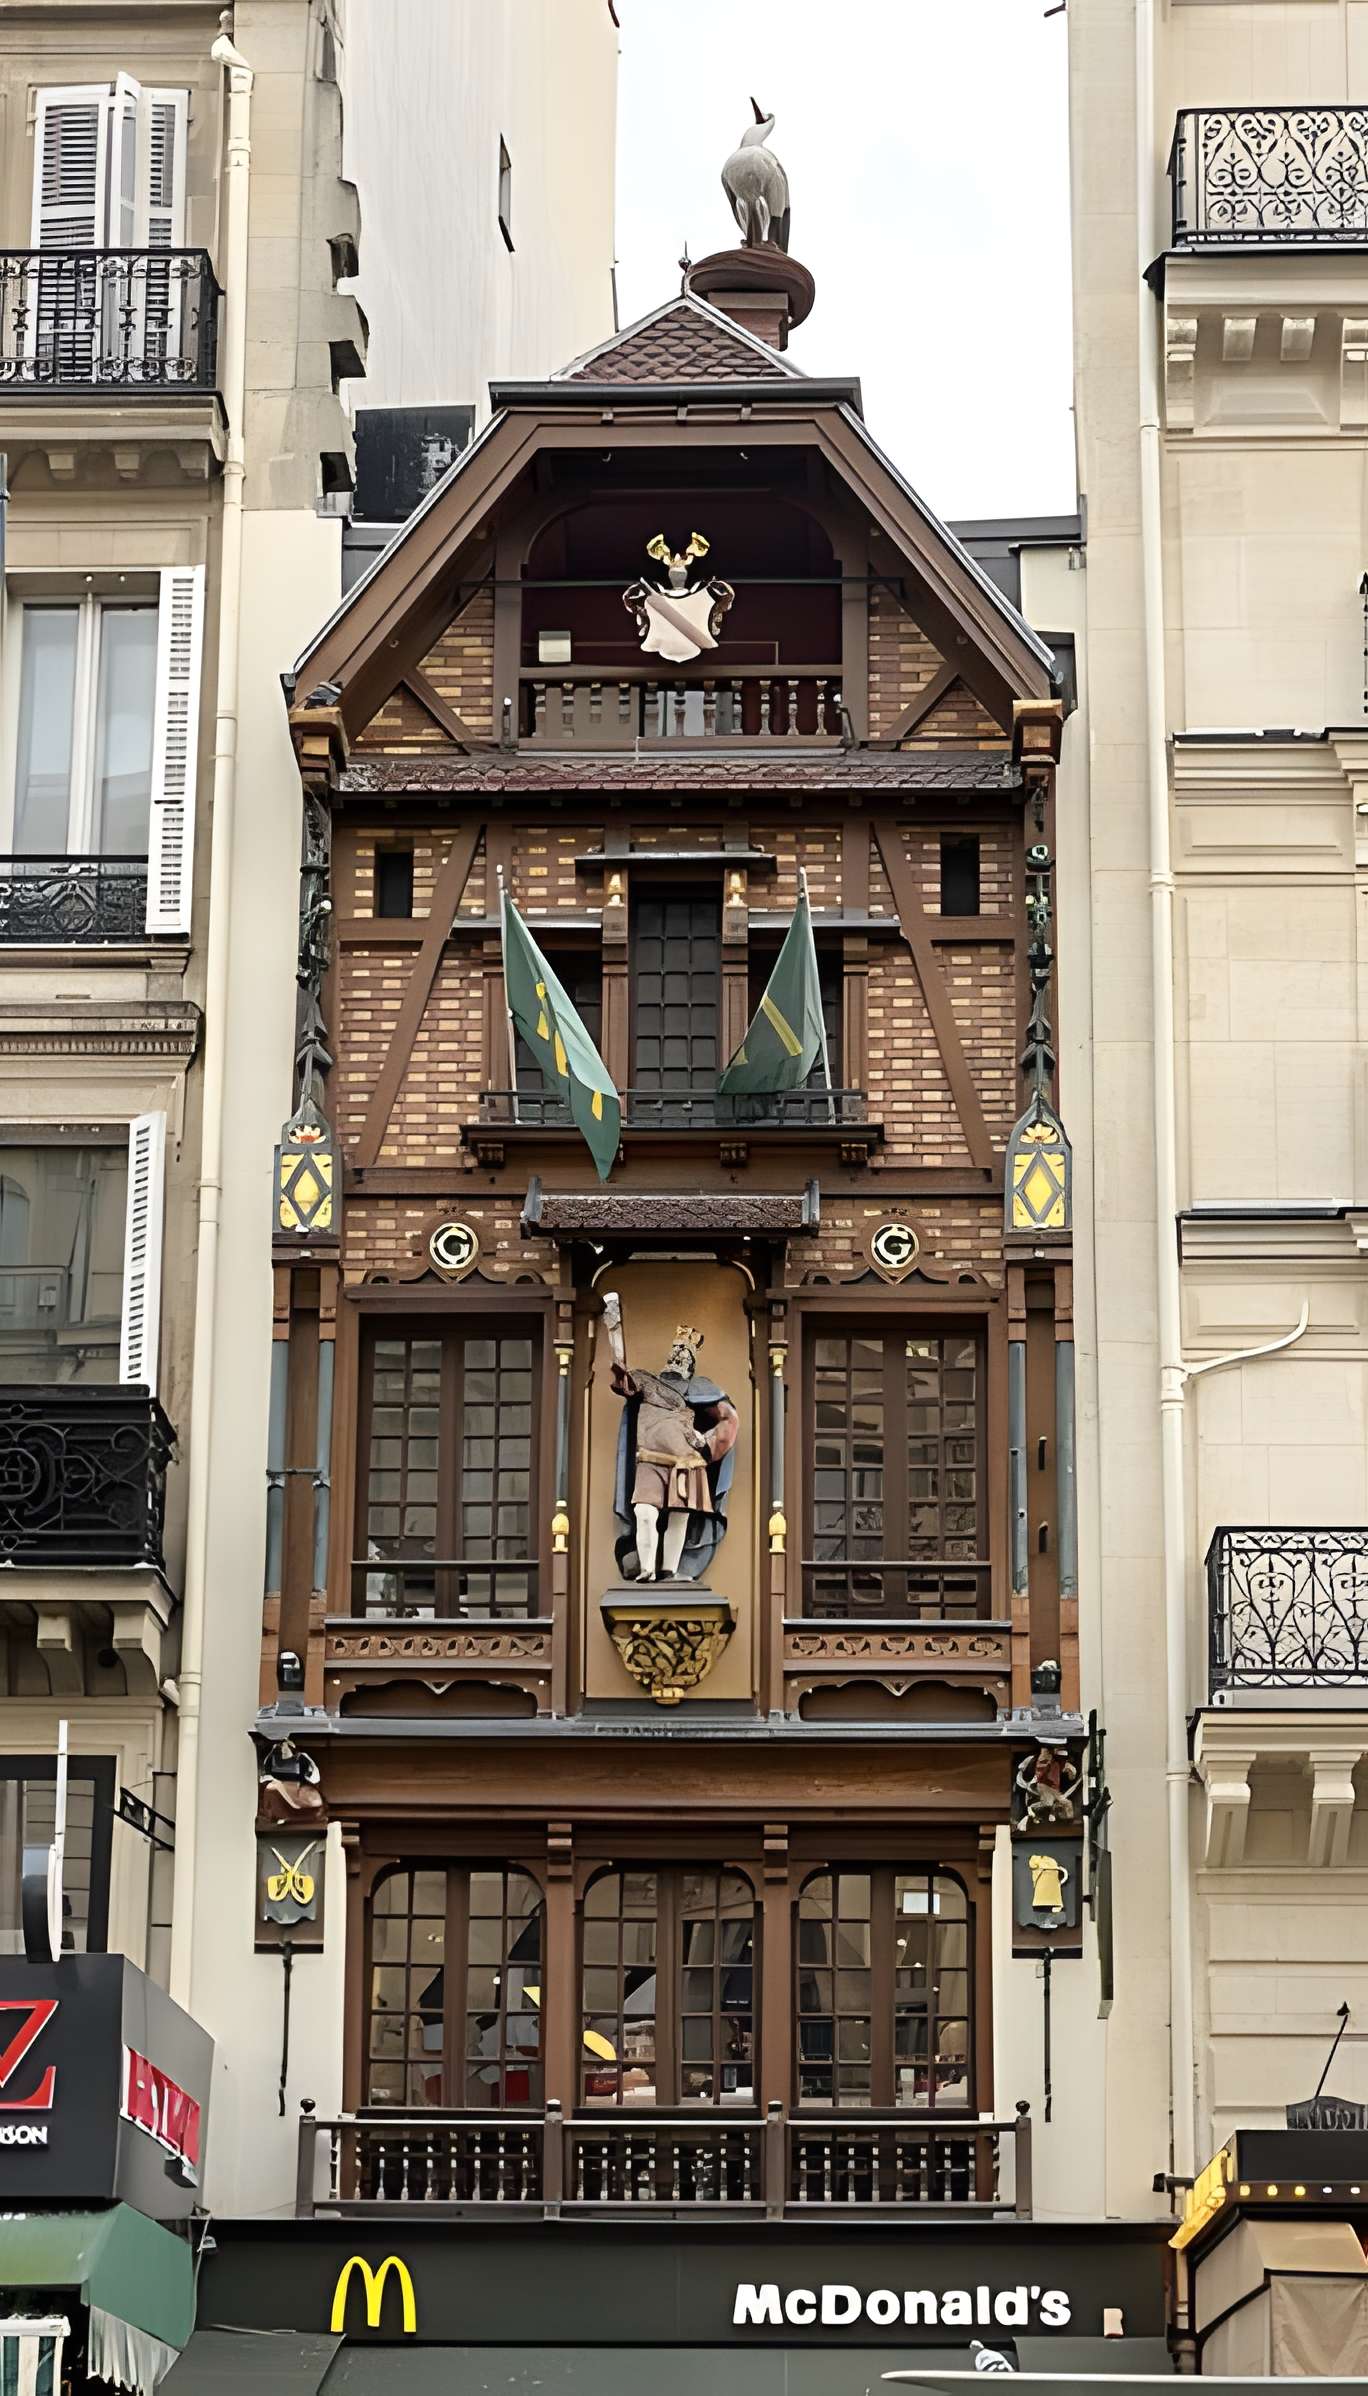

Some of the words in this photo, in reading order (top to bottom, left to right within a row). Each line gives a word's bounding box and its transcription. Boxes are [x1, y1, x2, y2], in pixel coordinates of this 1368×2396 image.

[435, 1226, 472, 1265] G
[875, 1226, 913, 1265] G
[0, 2125, 48, 2144] SON
[331, 2255, 416, 2332] M
[732, 2284, 1071, 2326] McDonald's
